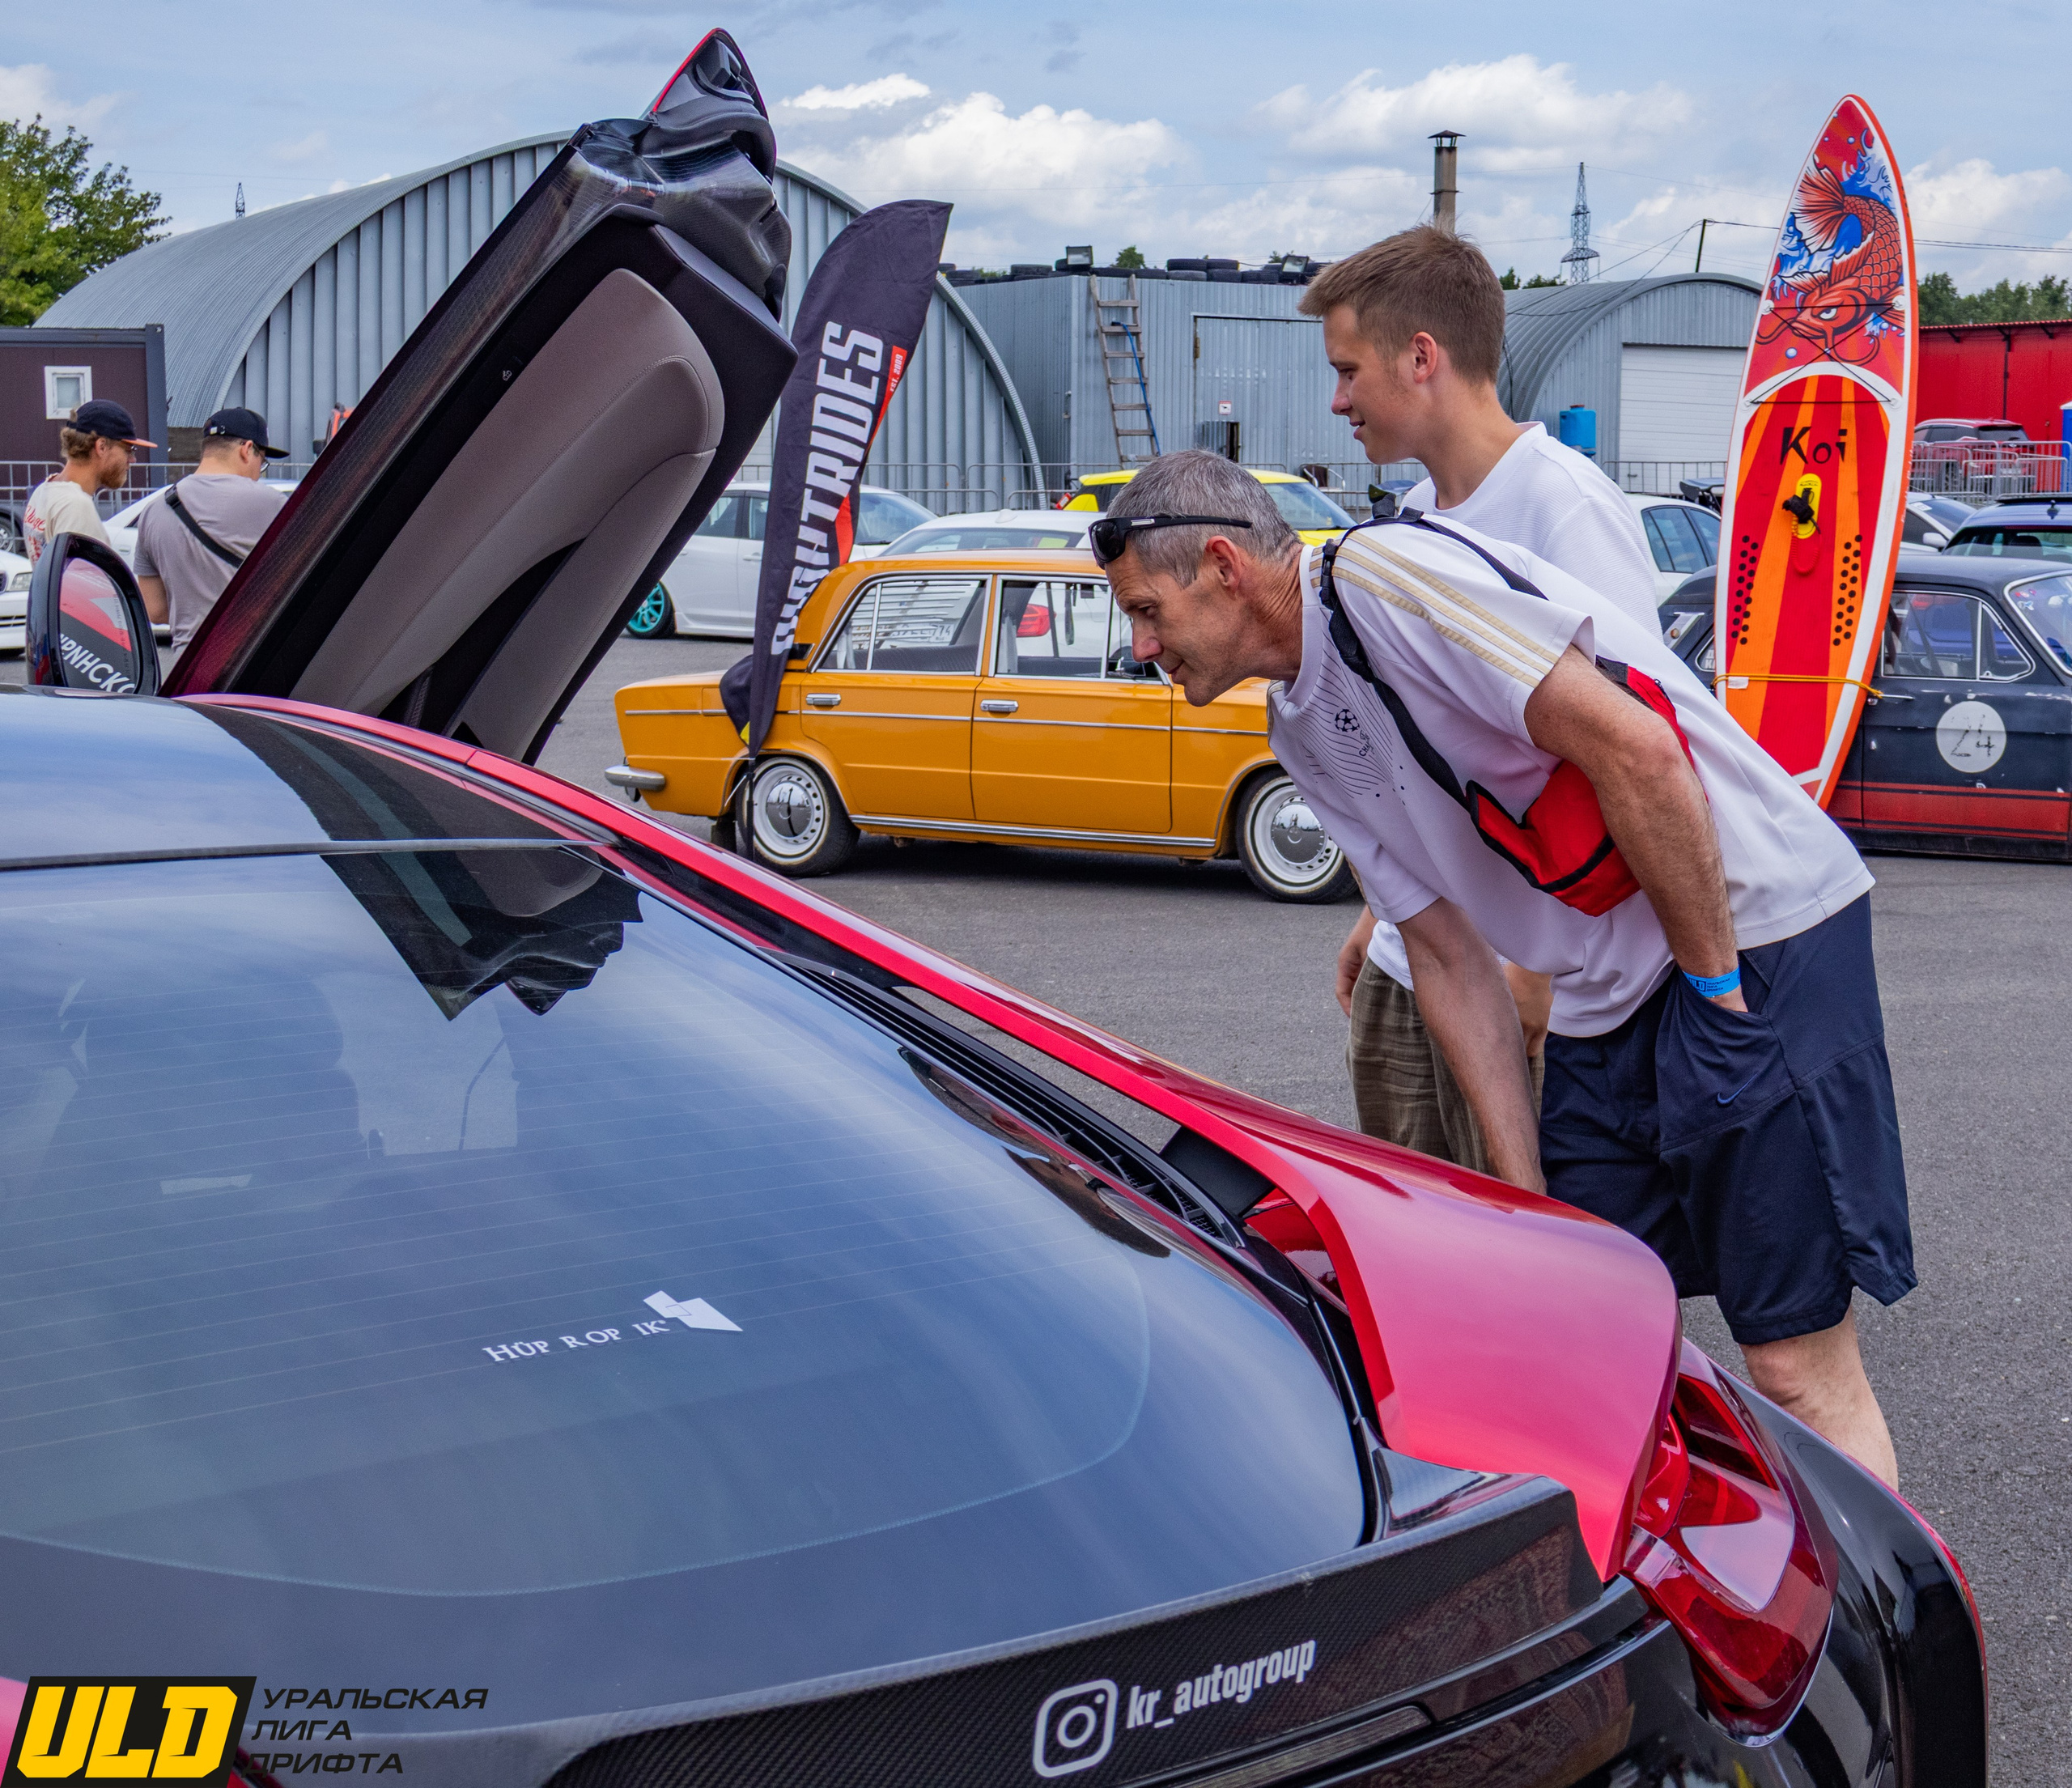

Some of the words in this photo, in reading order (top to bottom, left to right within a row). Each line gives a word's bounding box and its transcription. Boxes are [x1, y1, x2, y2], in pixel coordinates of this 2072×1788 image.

[894, 353, 903, 376] 2009
[1780, 426, 1848, 465] Koi
[1126, 1639, 1317, 1729] kr_autogroup
